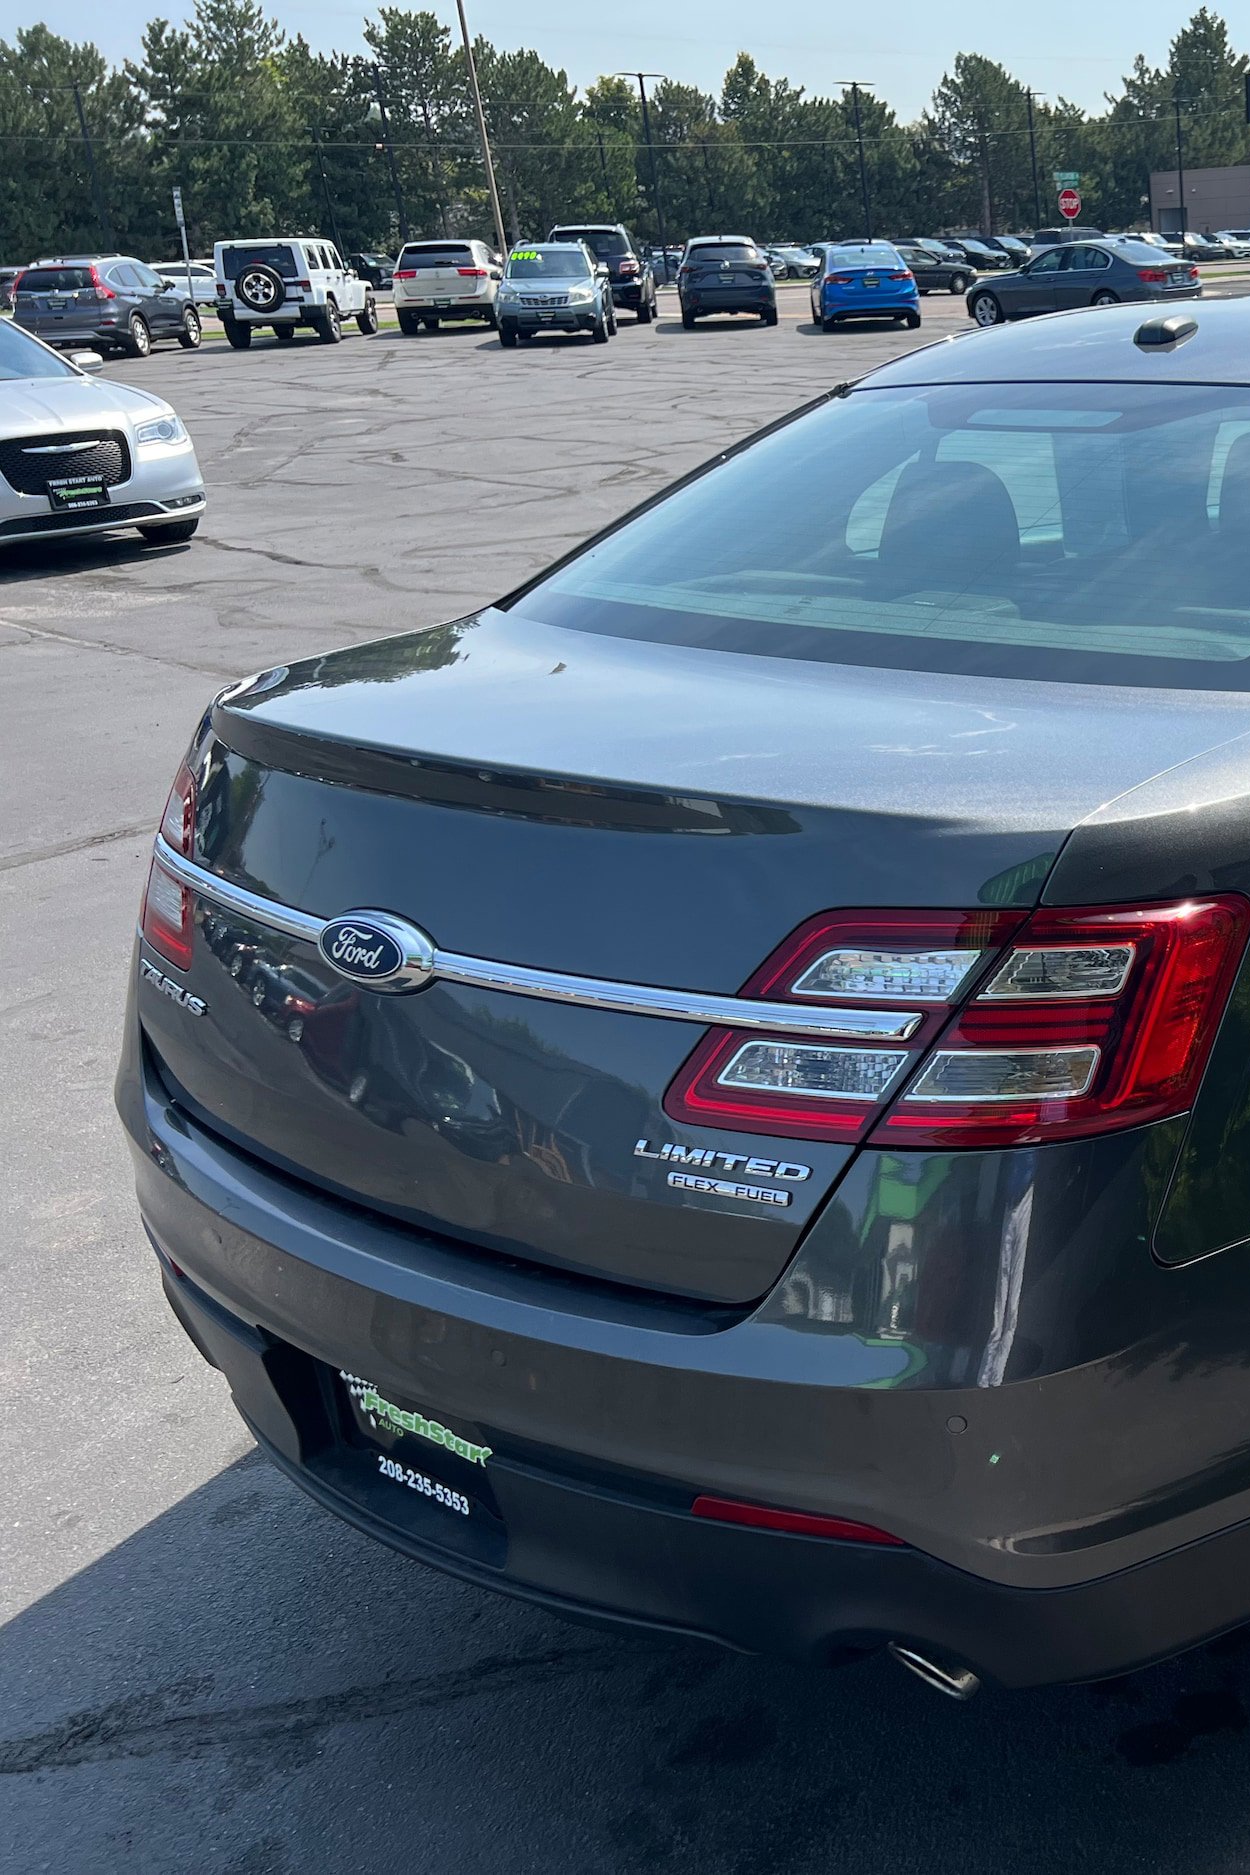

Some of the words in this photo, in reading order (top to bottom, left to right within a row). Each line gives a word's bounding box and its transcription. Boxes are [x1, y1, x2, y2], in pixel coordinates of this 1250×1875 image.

[1060, 198, 1079, 210] STOP
[332, 927, 384, 970] Ford
[140, 959, 208, 1016] TAURUS
[634, 1139, 813, 1181] LIMITED
[673, 1175, 719, 1193] FLEX
[735, 1186, 784, 1204] FUEL
[378, 1418, 405, 1438] AUTO
[378, 1455, 470, 1515] 208-235-5353
